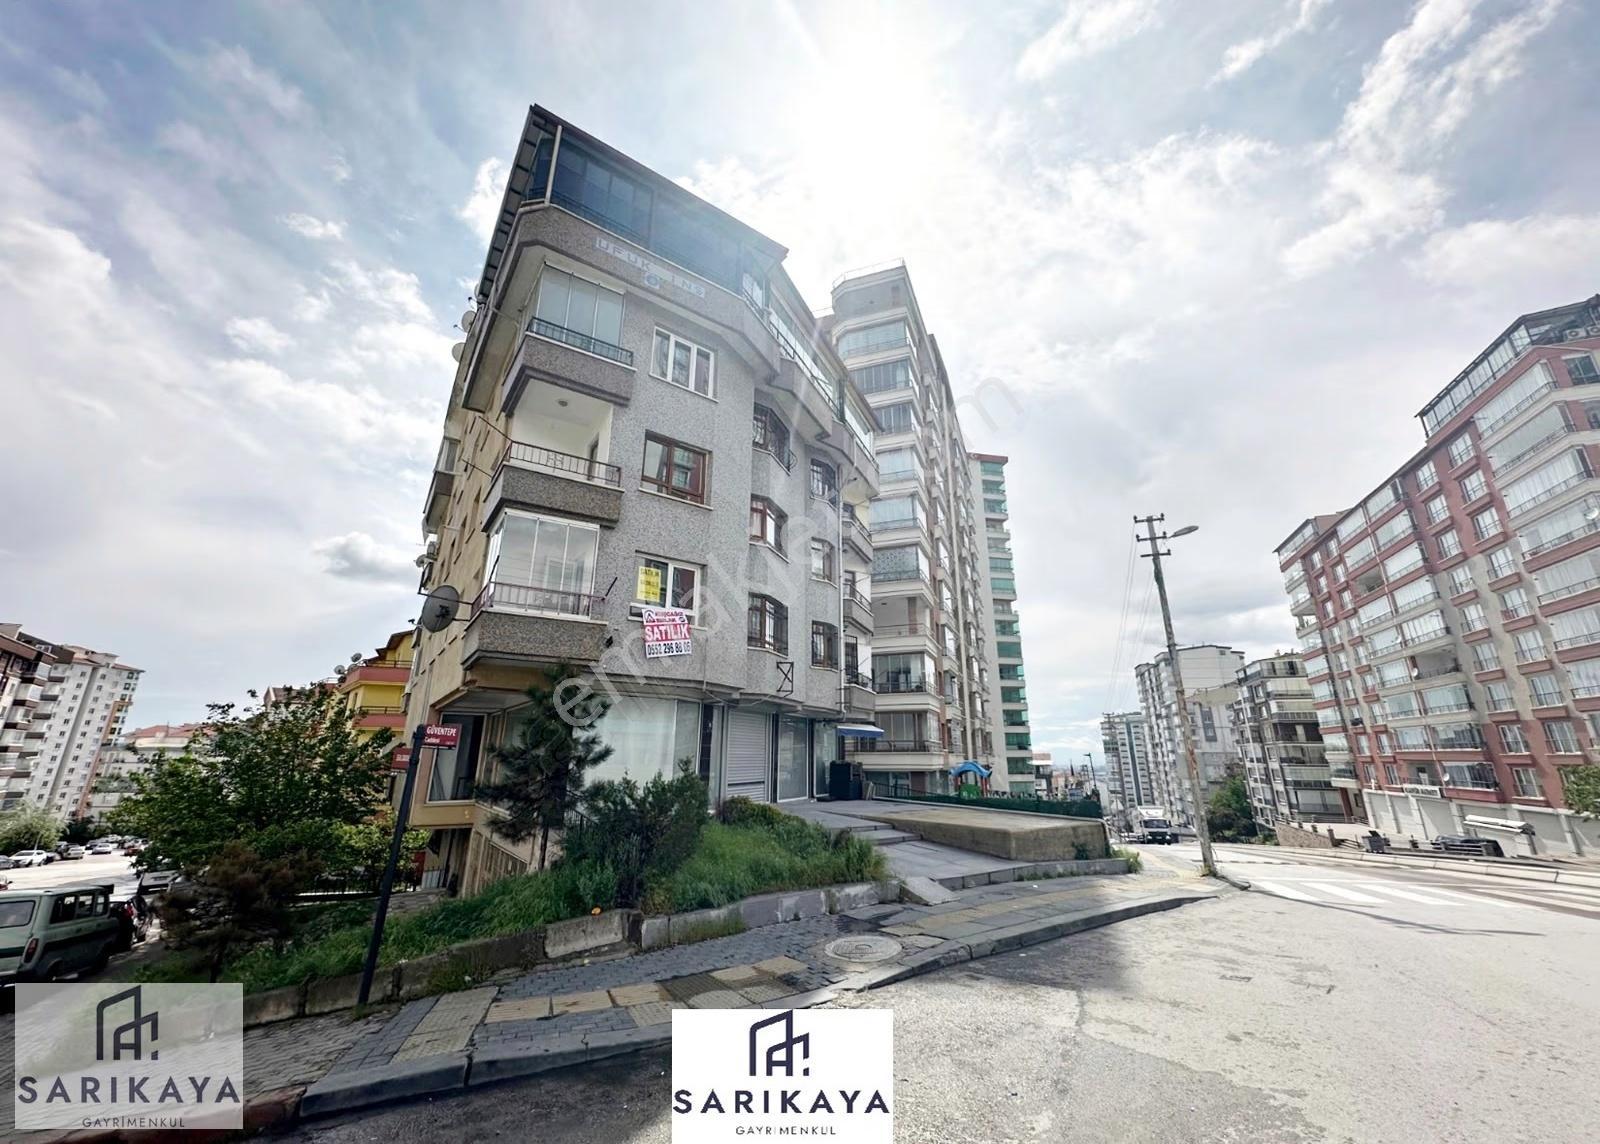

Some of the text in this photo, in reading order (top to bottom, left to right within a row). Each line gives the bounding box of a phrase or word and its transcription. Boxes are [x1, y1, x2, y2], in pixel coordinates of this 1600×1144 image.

[645, 624, 689, 641] SATILIK
[647, 643, 662, 655] 0552
[663, 642, 674, 654] 296
[426, 724, 457, 736] GÜVENTEPE
